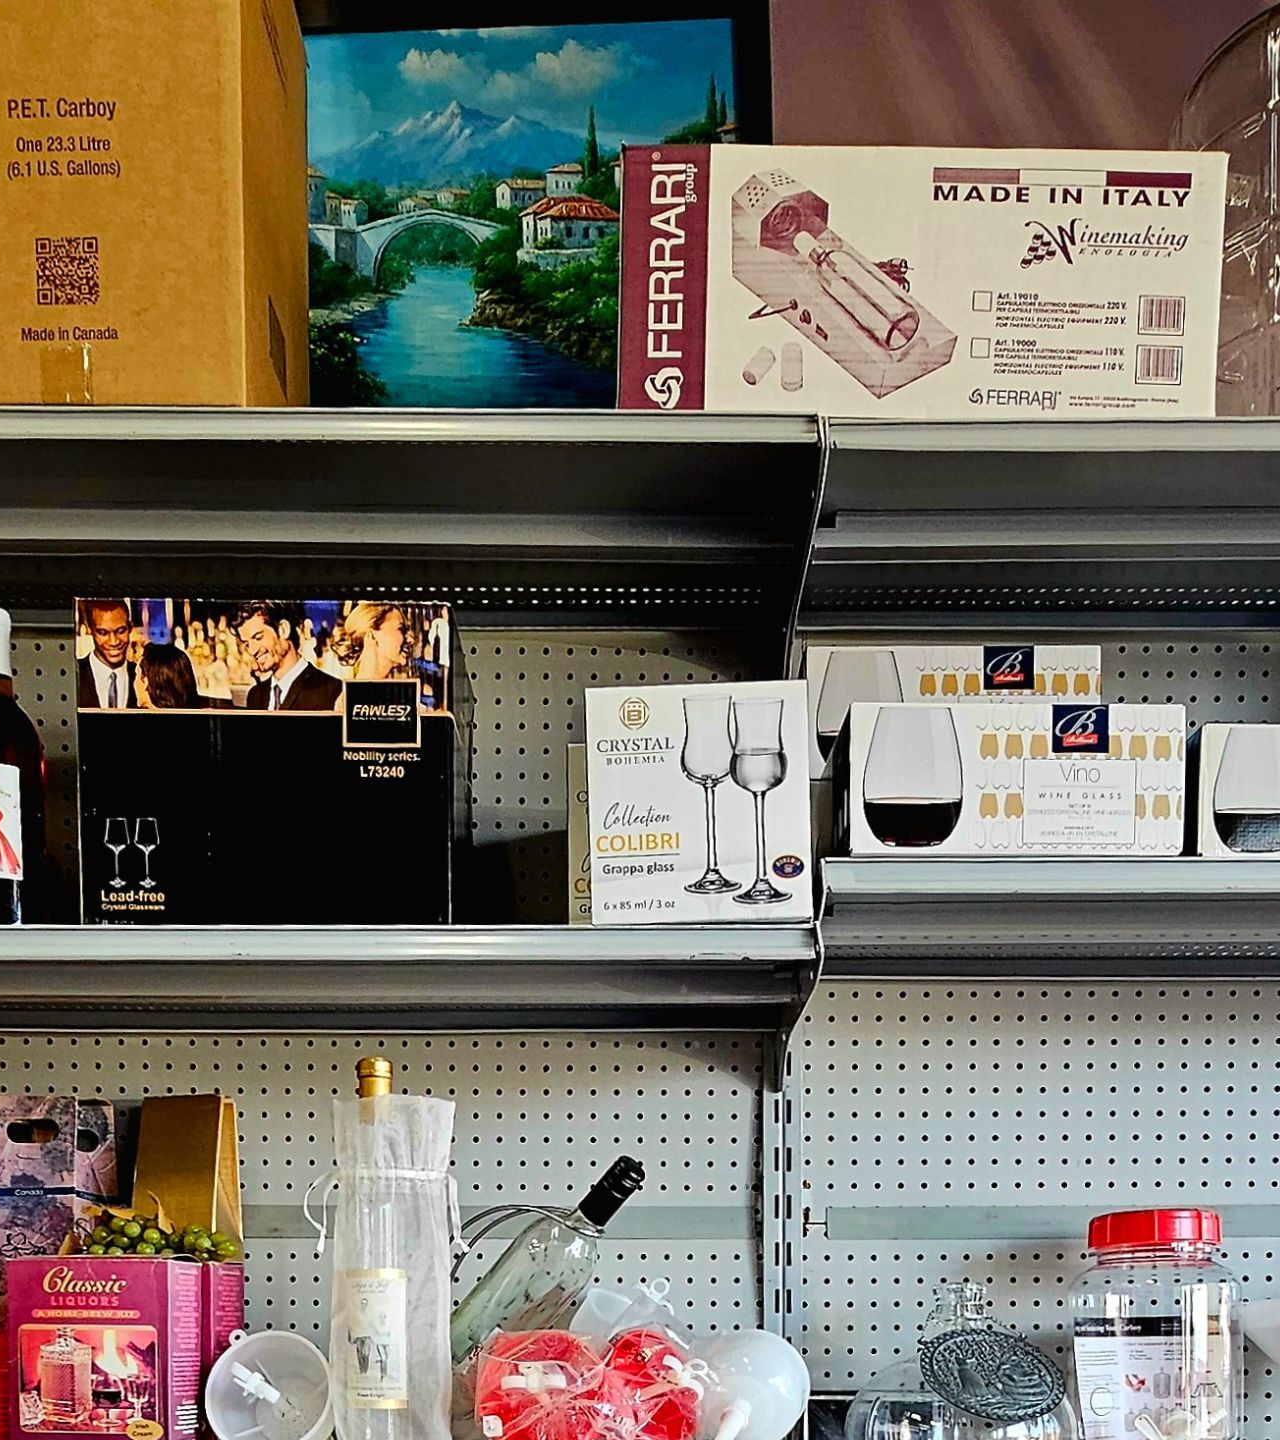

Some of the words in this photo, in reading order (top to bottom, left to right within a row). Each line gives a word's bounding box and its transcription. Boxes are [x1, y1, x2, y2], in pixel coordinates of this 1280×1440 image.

[7, 98, 51, 119] P.E.T.
[56, 97, 117, 121] Carboy
[15, 137, 44, 153] One
[46, 136, 76, 152] 23.3
[79, 136, 111, 152] Litre
[7, 161, 32, 180] (6.1
[37, 161, 63, 177] U.S.
[66, 160, 121, 178] Gallons)
[684, 163, 698, 203] group
[933, 185, 1030, 203] MADE
[1049, 187, 1083, 204] IN
[1102, 189, 1191, 208] ITALY
[1024, 217, 1189, 266] Winemaking
[647, 162, 688, 358] FERRARI
[1078, 248, 1172, 258] ENOLOGIA
[1013, 293, 1039, 301] 19010
[21, 327, 55, 342] Made
[58, 327, 70, 341] in
[73, 327, 119, 341] Canada
[1011, 340, 1037, 348] 19000
[352, 704, 405, 717] FAWLES
[596, 736, 675, 754] CRYSTAL
[343, 751, 385, 764] Nobility
[606, 755, 665, 766] BOHEMIA
[360, 765, 405, 778] L73240
[1060, 763, 1101, 783] Vino
[1082, 792, 1122, 800] GLASS
[603, 802, 672, 830] Collection
[596, 832, 680, 853] COLIBRI
[602, 862, 644, 877] Grappa
[646, 863, 675, 875] glass
[604, 901, 610, 911] 6
[619, 900, 632, 910] 85
[634, 900, 647, 910] ml
[656, 900, 662, 909] 3
[664, 900, 675, 909] oz
[43, 1265, 128, 1294] Classic
[50, 1296, 120, 1307] LIQUORS
[132, 1430, 154, 1438] Cream
